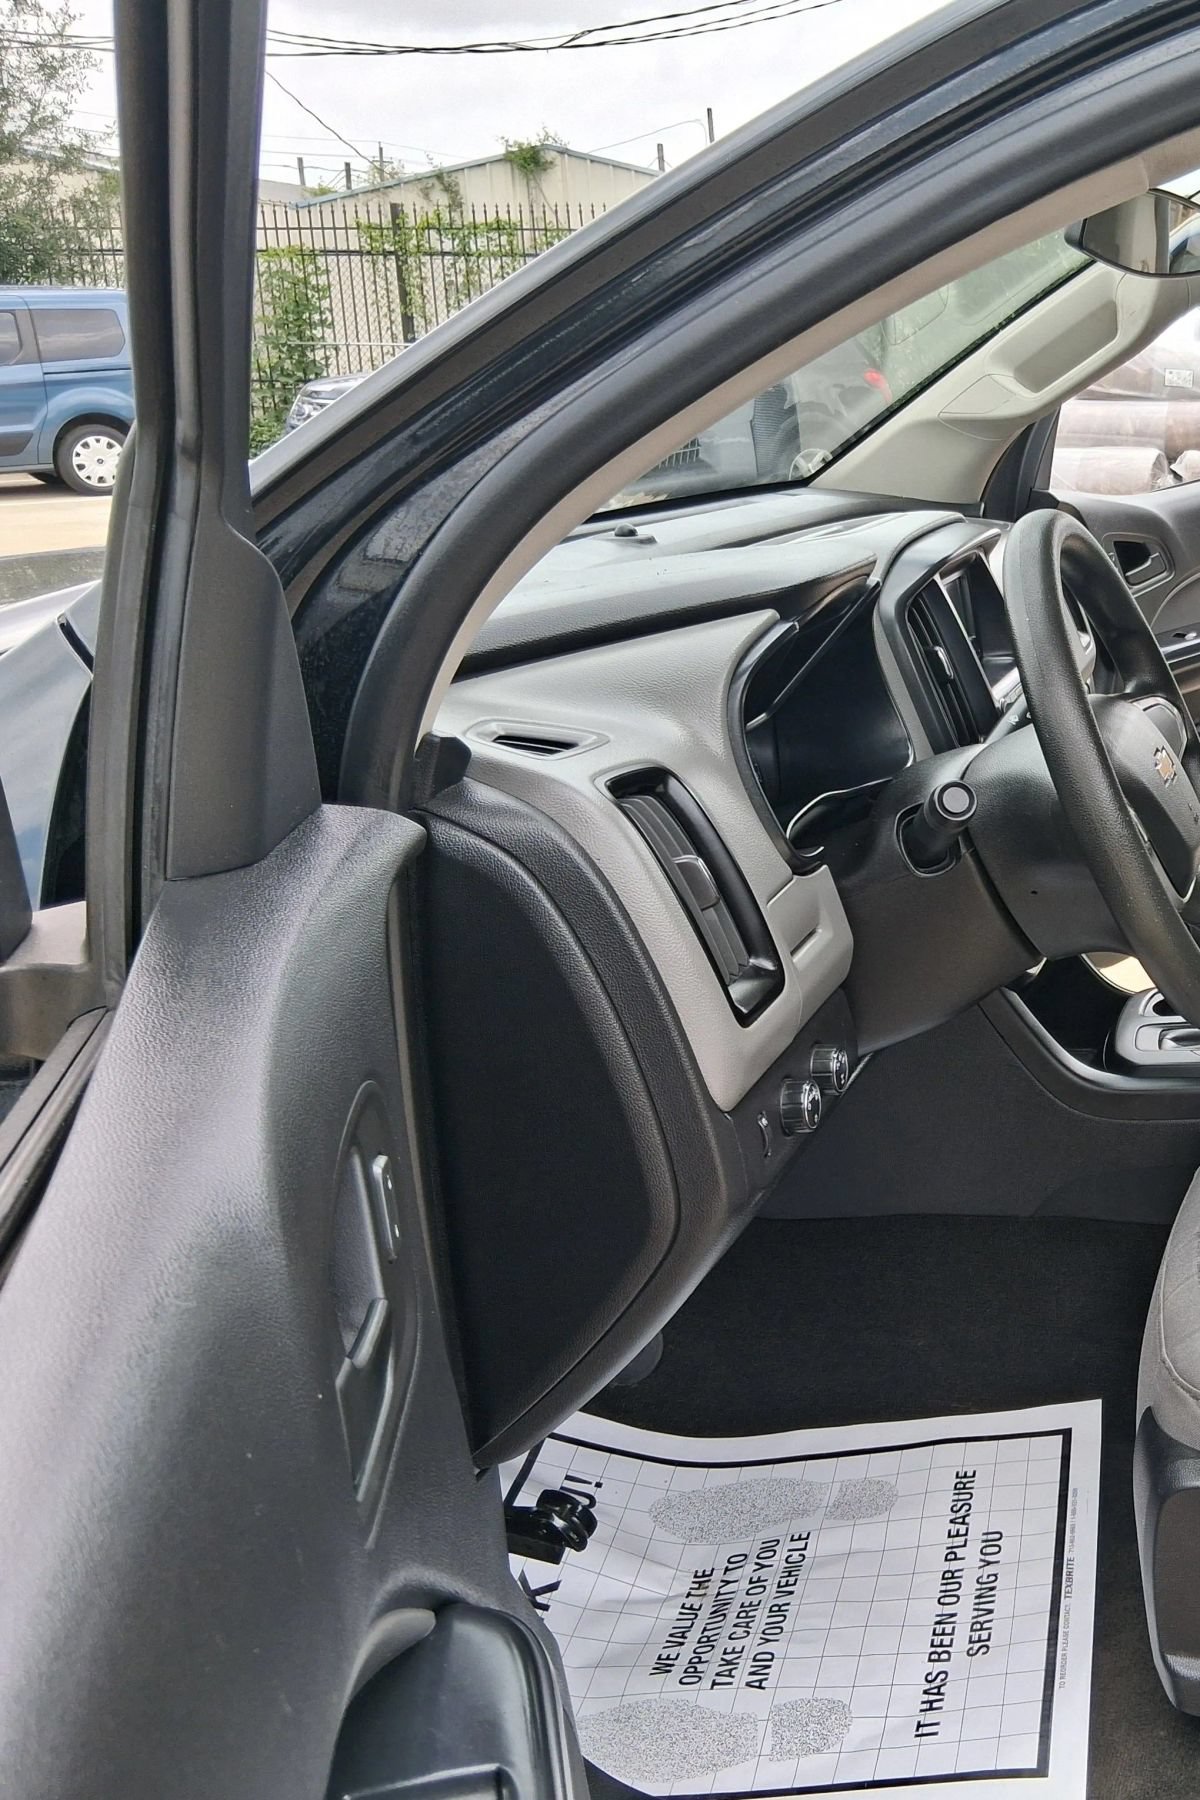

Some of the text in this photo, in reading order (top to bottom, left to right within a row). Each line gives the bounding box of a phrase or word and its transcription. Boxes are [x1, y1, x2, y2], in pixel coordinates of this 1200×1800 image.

[649, 1568, 714, 1676] WE VALUE THE
[679, 1553, 748, 1686] OPPORTUNITY TO
[710, 1539, 780, 1690] TAKE CARE OF YOU
[745, 1532, 810, 1690] AND YOUR VEHICLE
[914, 1470, 976, 1738] IT HAS BEEN OUR PLEASURE
[966, 1531, 1002, 1657] SERVING YOU
[1062, 1630, 1070, 1651] PLEASE
[1064, 1556, 1074, 1600] TEXBRITE
[1060, 1652, 1068, 1680] REORDER
